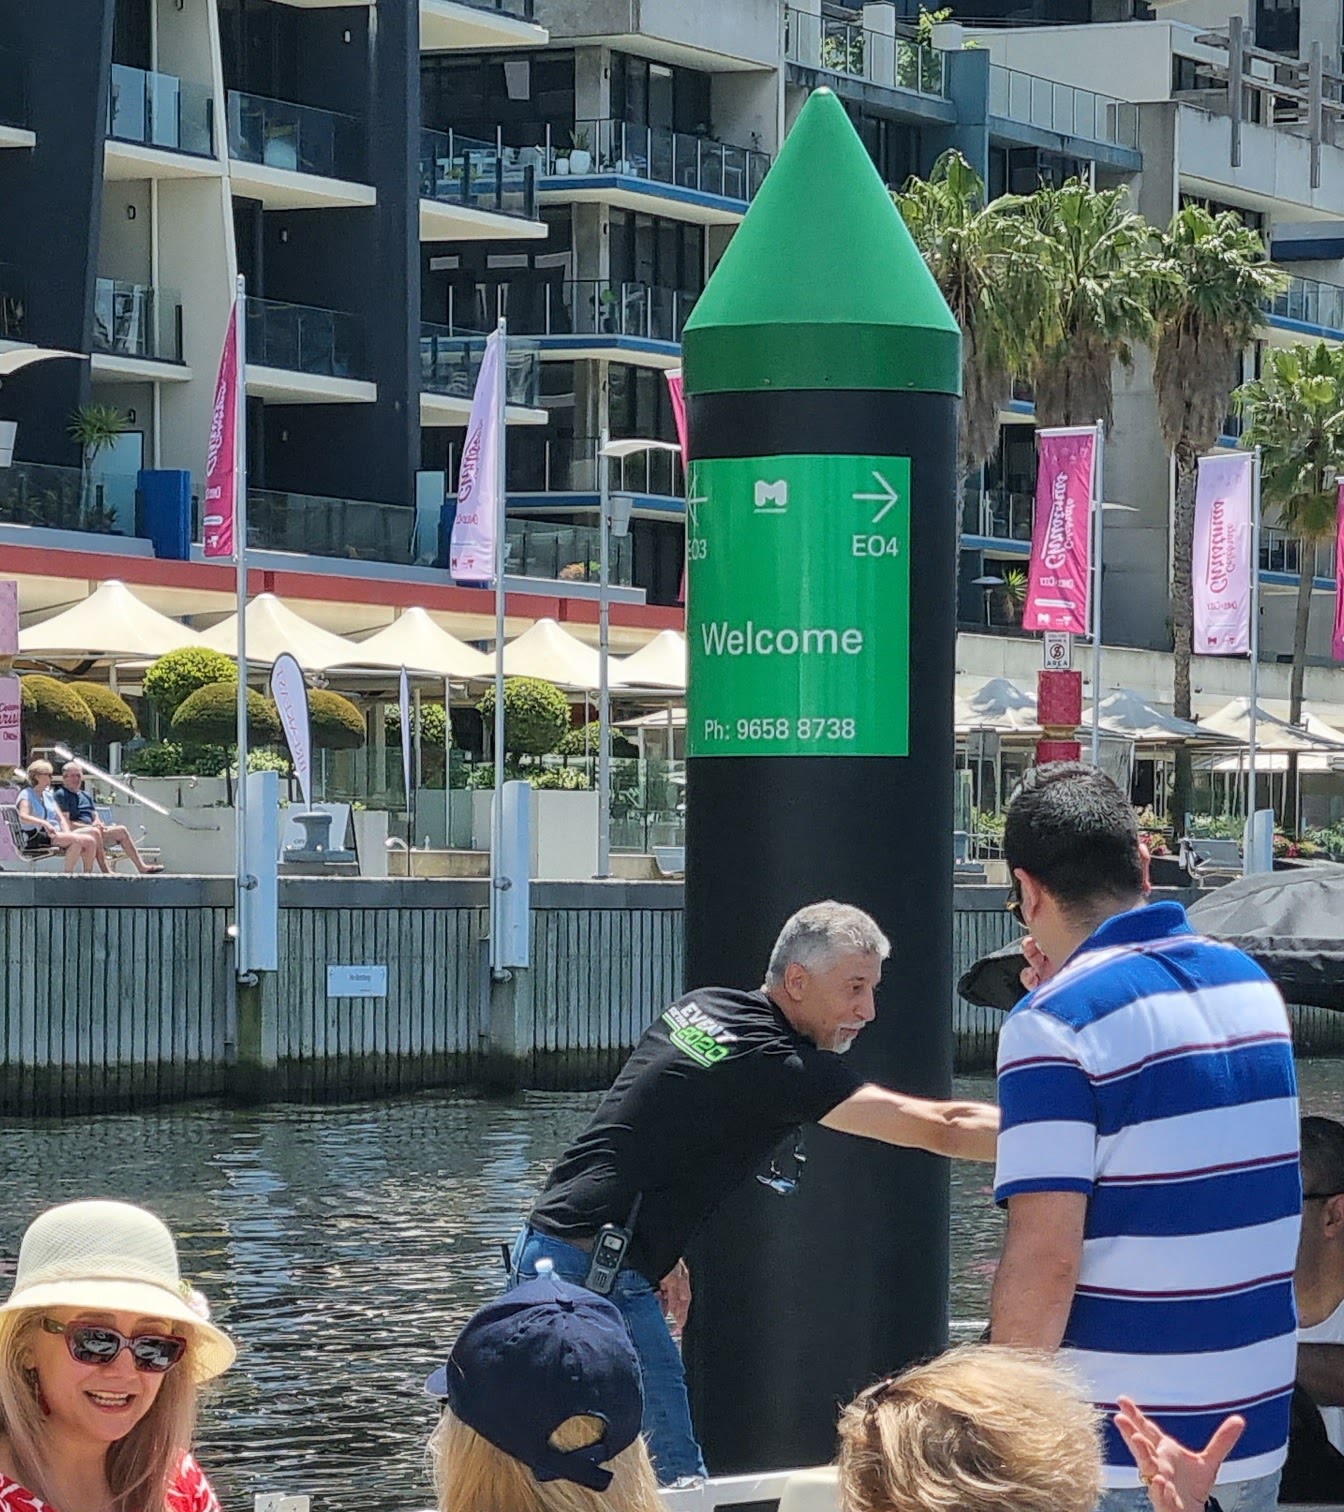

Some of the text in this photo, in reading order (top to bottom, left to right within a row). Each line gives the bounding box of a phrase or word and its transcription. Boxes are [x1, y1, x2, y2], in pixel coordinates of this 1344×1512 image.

[701, 621, 864, 656] Welcome
[704, 718, 856, 741] Ph: 9658 8738
[677, 1026, 730, 1062] 2020
